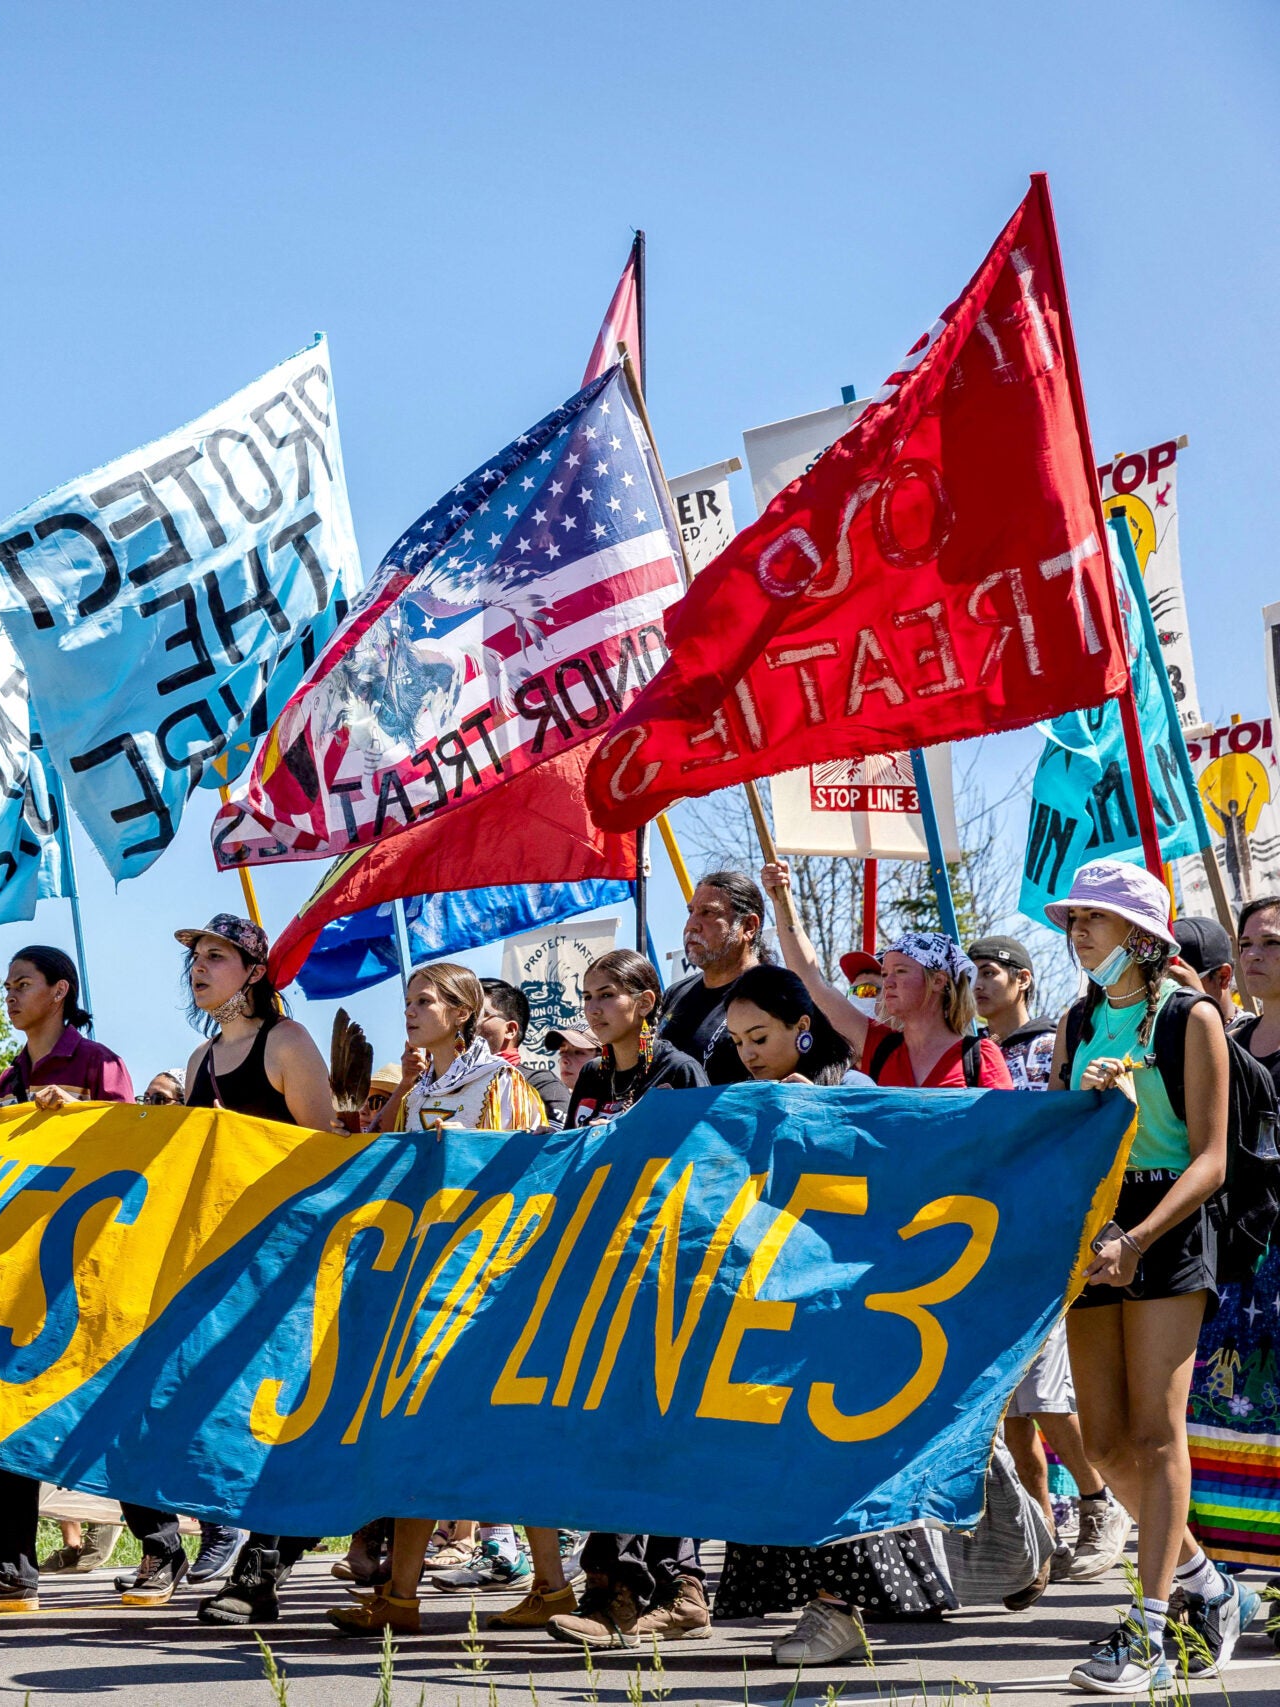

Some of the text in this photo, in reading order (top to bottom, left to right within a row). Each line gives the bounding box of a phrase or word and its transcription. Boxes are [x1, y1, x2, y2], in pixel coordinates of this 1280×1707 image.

[1097, 440, 1177, 494] TOP
[677, 489, 721, 525] ER
[682, 526, 701, 541] ED
[1177, 710, 1198, 730] IS
[815, 787, 919, 811] STOP LINE 3
[524, 935, 595, 973] PROTECT WATE
[250, 1157, 1000, 1446] STOP LINE 3
